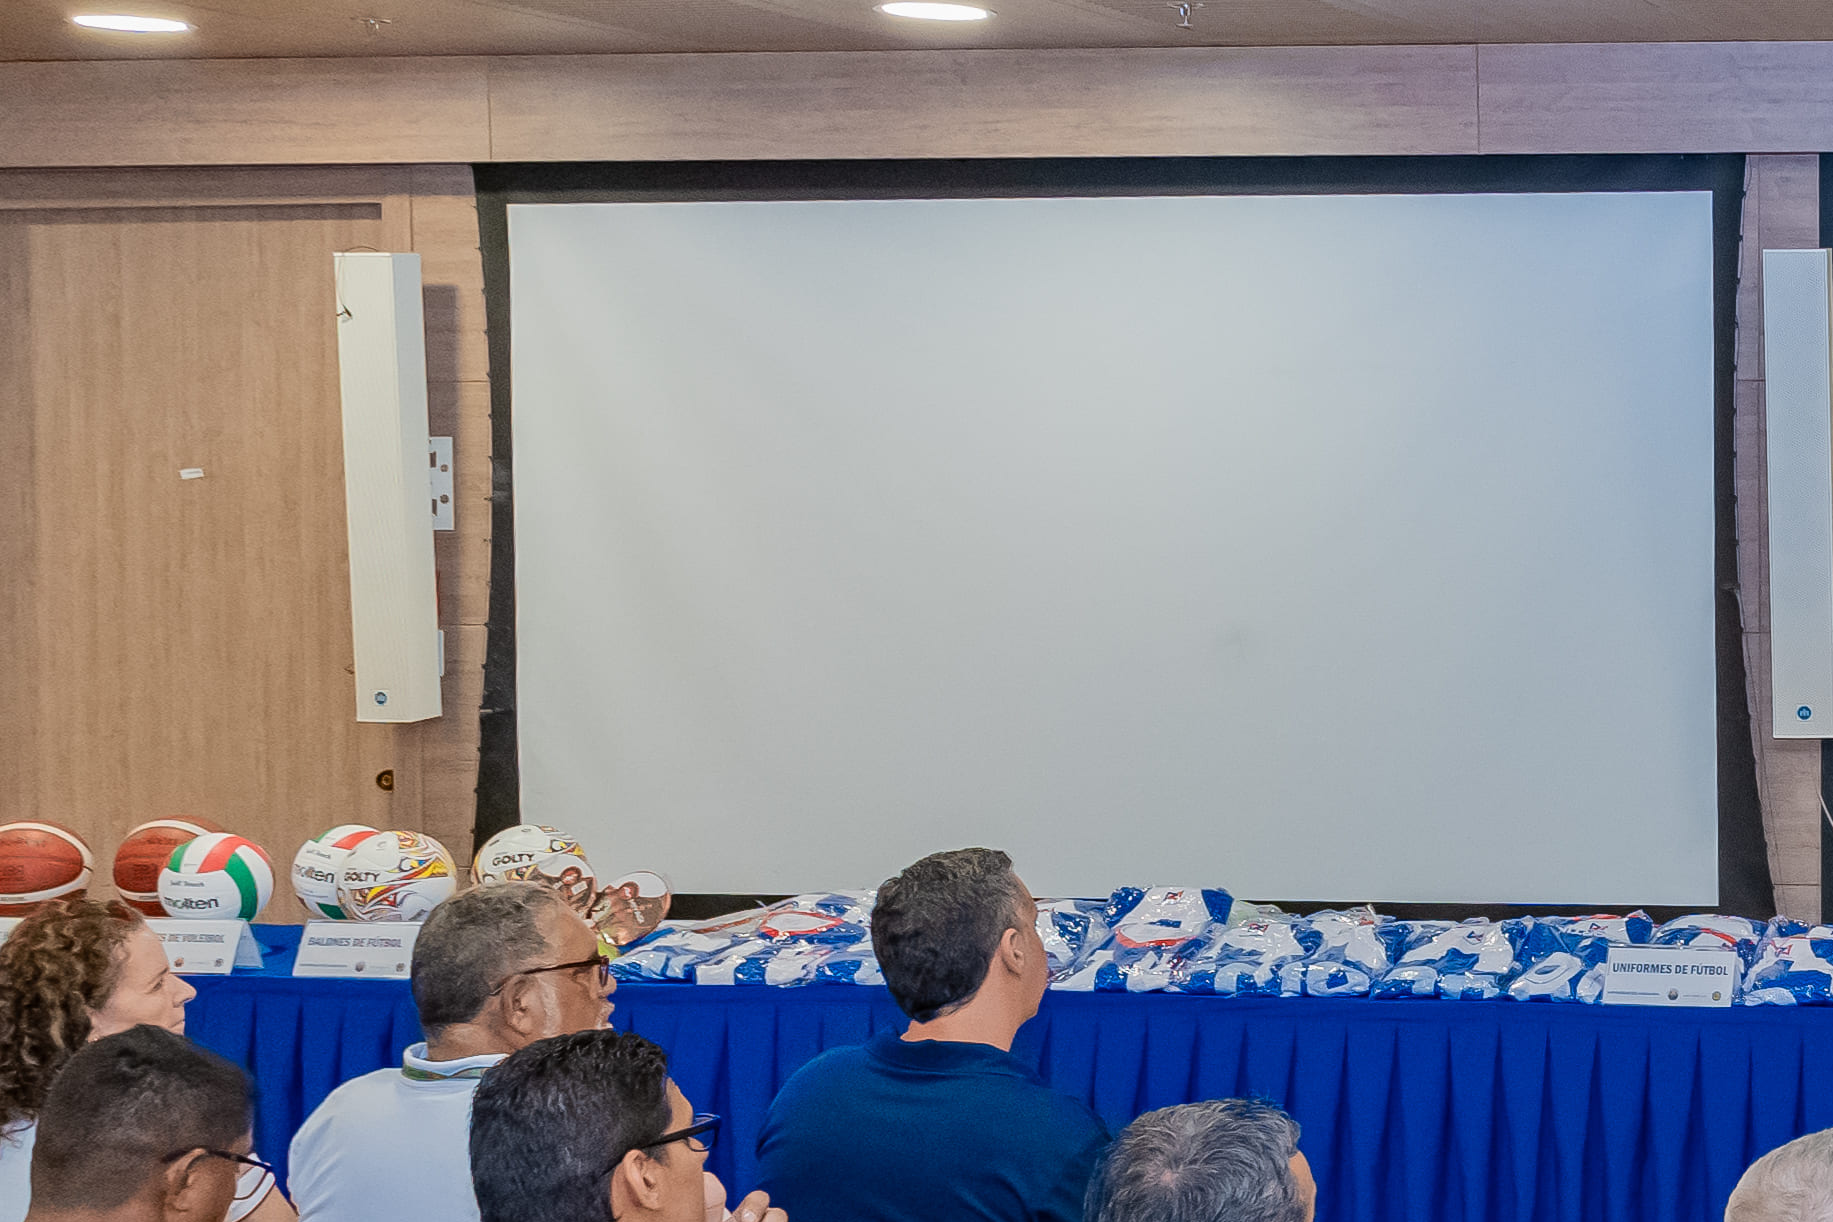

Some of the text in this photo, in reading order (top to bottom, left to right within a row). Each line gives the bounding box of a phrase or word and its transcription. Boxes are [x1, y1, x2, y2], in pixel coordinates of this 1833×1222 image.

[493, 852, 535, 867] GOLTY
[344, 871, 381, 882] GOLTY
[1612, 962, 1729, 976] UNIFORMES DE FÚTBOL
